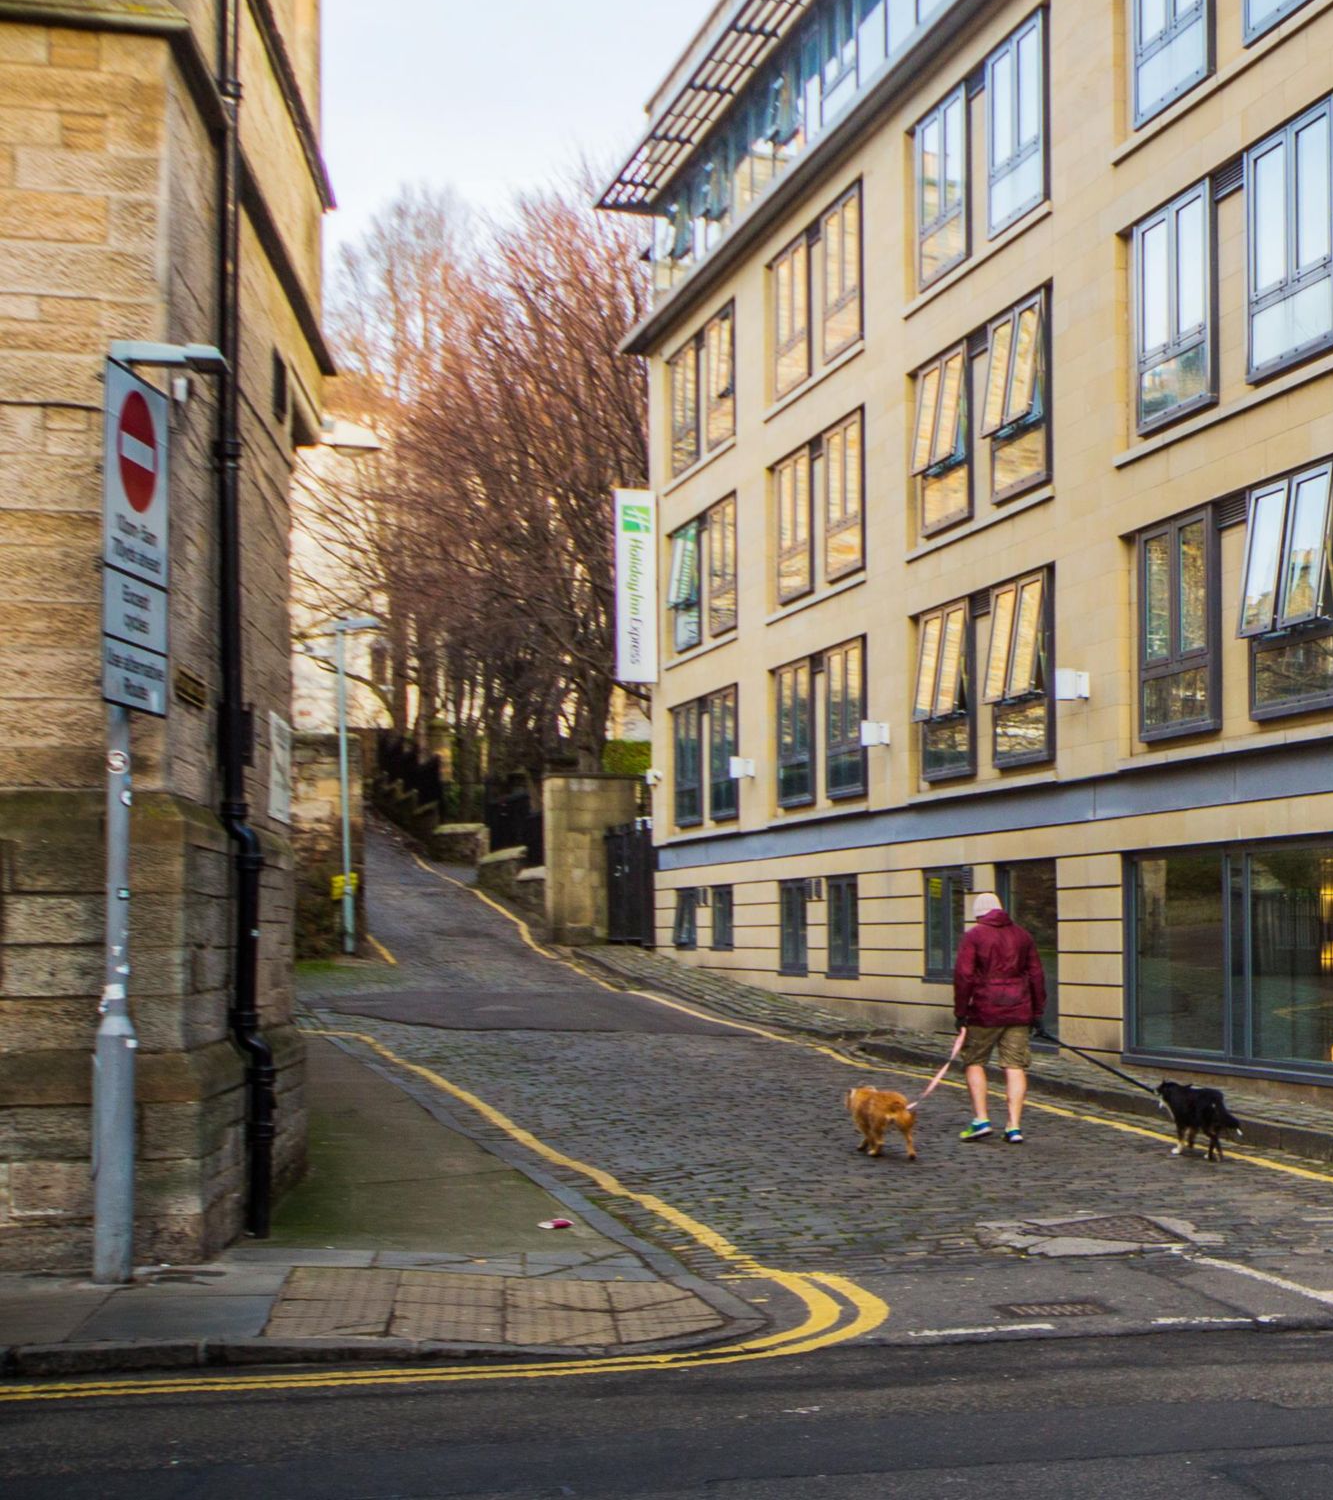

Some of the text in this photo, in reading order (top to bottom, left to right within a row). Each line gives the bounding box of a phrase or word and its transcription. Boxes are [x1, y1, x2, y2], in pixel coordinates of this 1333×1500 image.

[625, 537, 644, 666] Holiday Inn Express
